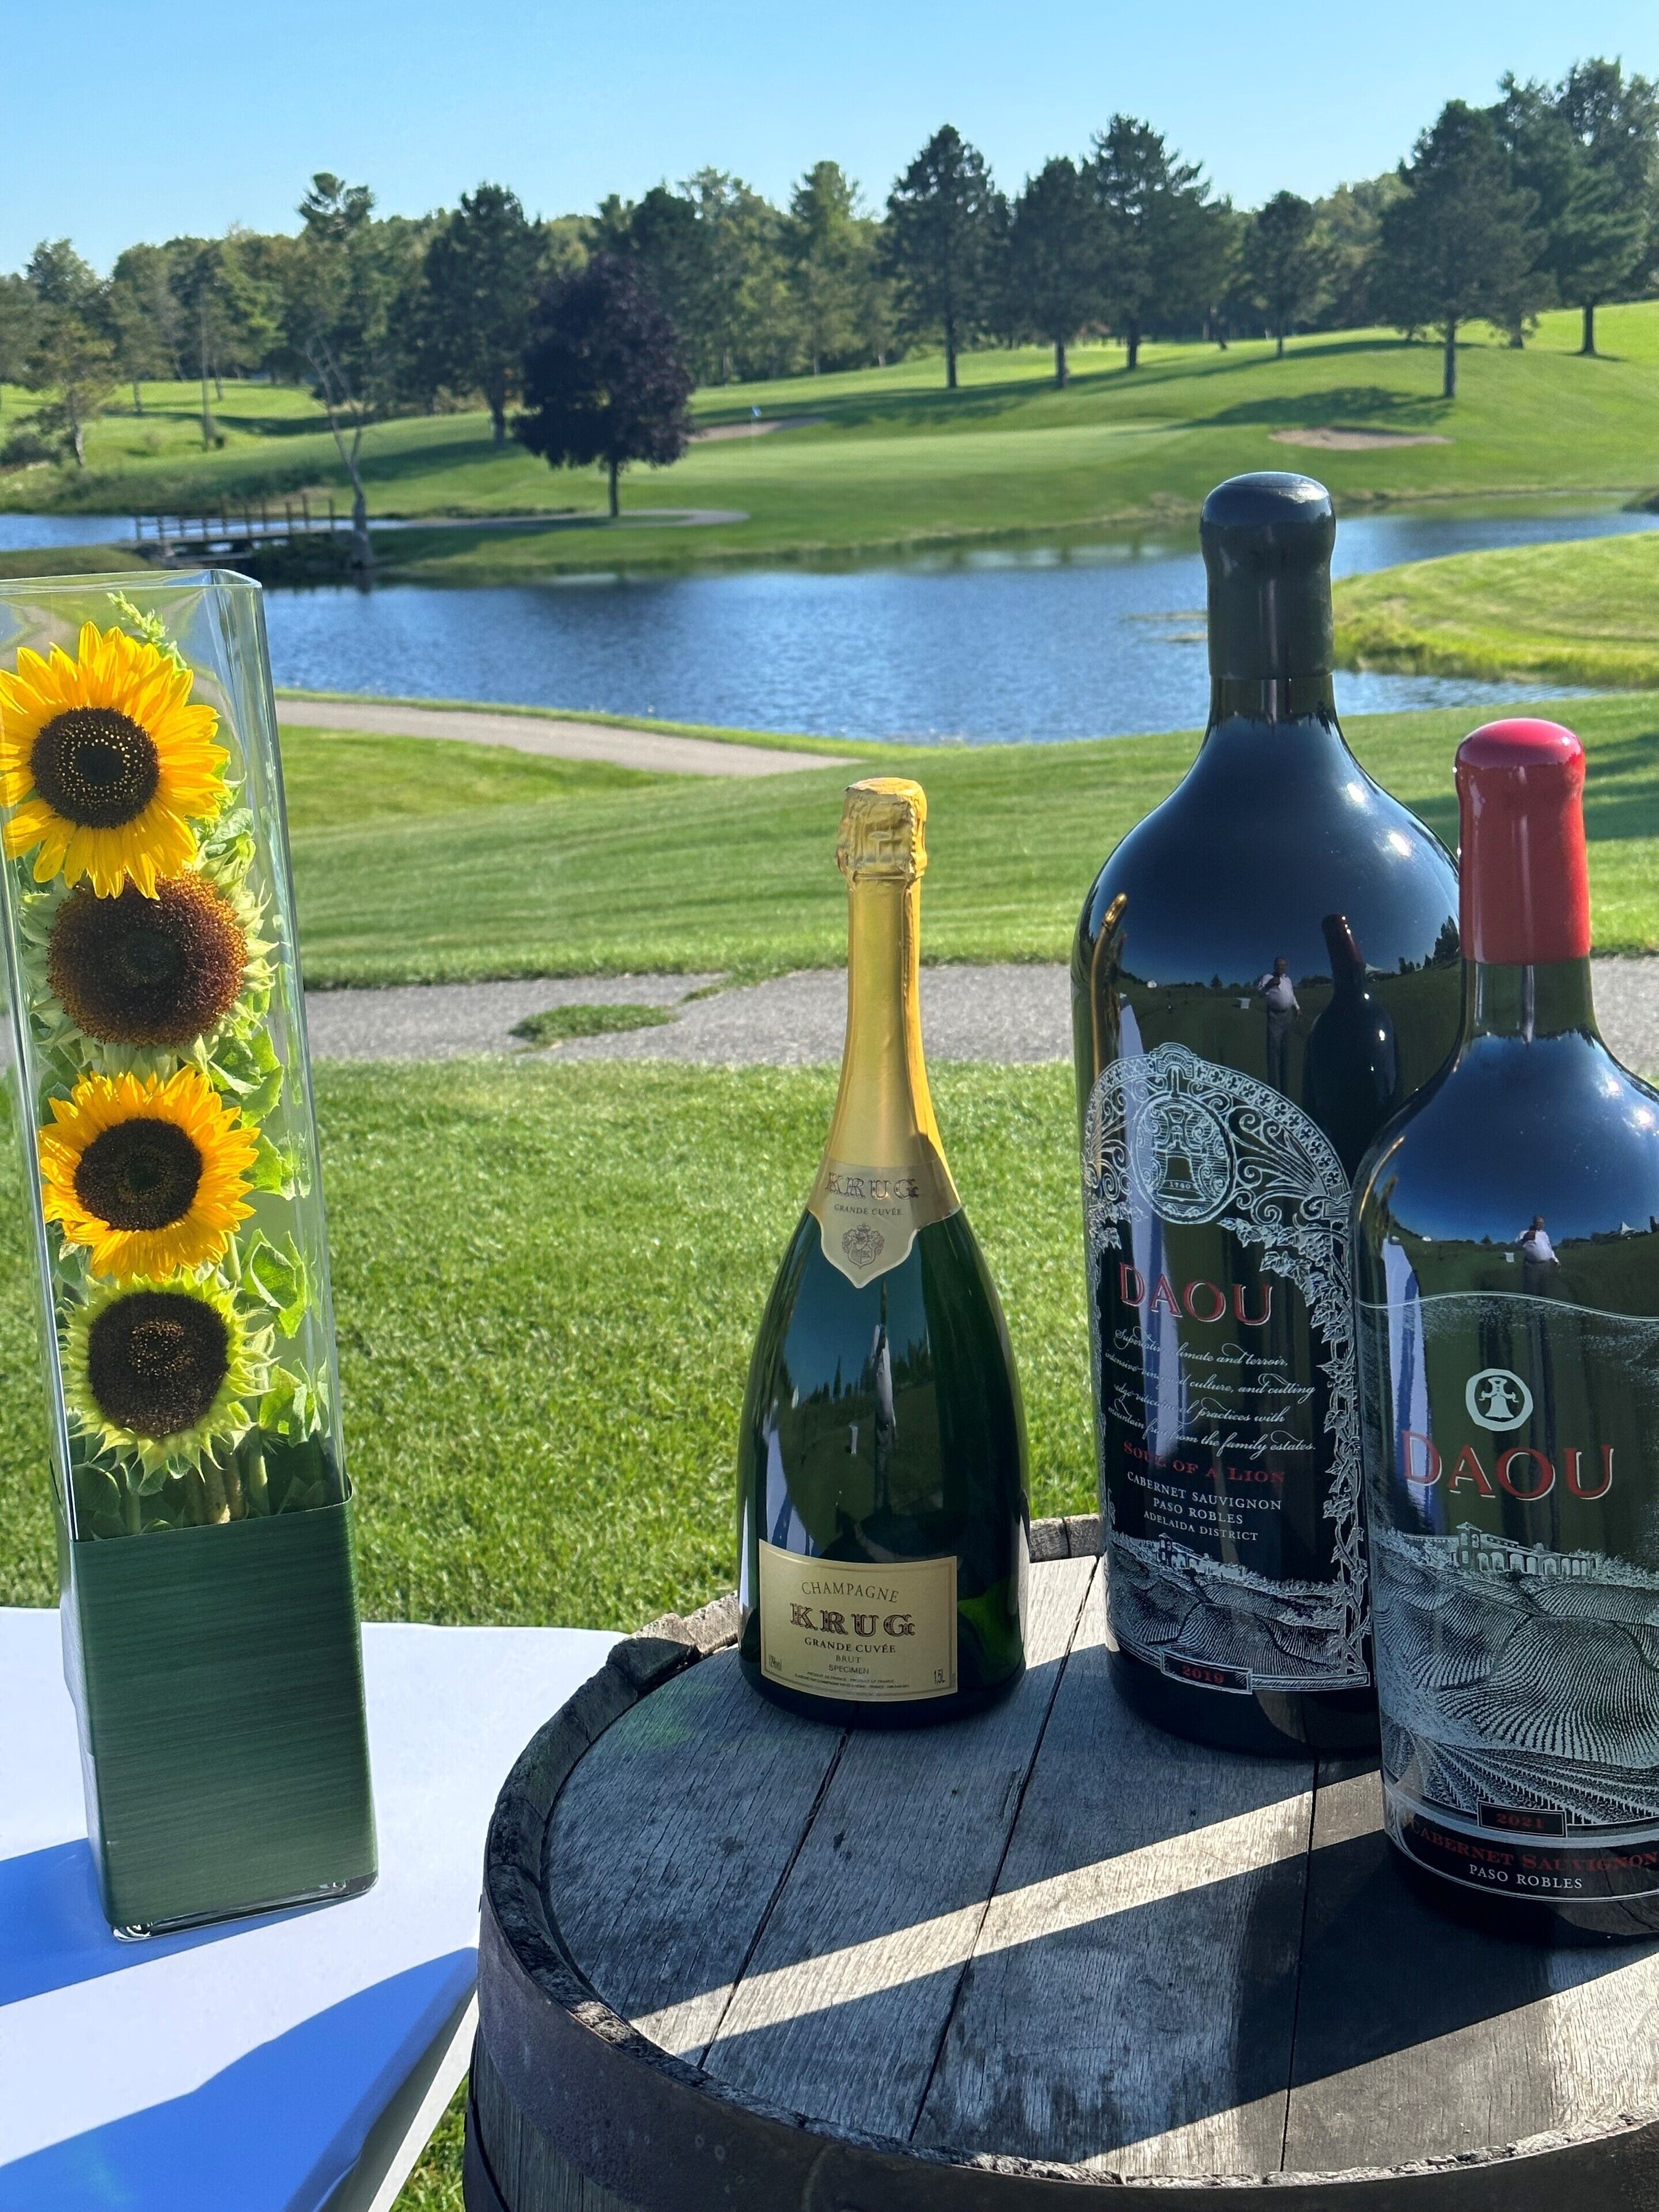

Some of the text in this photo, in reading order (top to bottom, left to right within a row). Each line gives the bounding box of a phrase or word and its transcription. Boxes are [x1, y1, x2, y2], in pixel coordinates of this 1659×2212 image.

[825, 1172, 919, 1200] KRUG
[834, 1204, 902, 1216] GRANDE CUVÉE
[1119, 1262, 1273, 1325] DAOU
[1216, 1351, 1248, 1365] and
[1243, 1346, 1288, 1366] terroir,
[1190, 1374, 1234, 1393] culture,
[1238, 1381, 1269, 1394] and
[1262, 1374, 1316, 1404] cutting
[1191, 1399, 1251, 1424] practices
[1254, 1406, 1290, 1422] with
[1200, 1430, 1220, 1446] the
[1216, 1432, 1268, 1460] family
[1270, 1430, 1316, 1450] estates.
[1172, 1460, 1199, 1474] OF
[1205, 1467, 1218, 1479] A
[1228, 1467, 1286, 1483] LION
[1402, 1430, 1614, 1501] DAOU
[1127, 1471, 1282, 1510] CABERNET SAUVIGNON
[1153, 1497, 1243, 1525] PASO ROBLES
[1143, 1510, 1259, 1541] ADELAIDA DISTRICT
[801, 1582, 899, 1603] CHAMPAGNE
[790, 1603, 915, 1637] KRUG
[805, 1637, 896, 1653] GRANDE CUVÉE
[828, 1664, 870, 1675] SPECIMEN
[836, 1654, 862, 1664] BRUT
[1182, 1665, 1225, 1684] 2019
[1497, 1813, 1544, 1828] 2021
[1411, 1819, 1659, 1871] CABERNET SAUVIGNON
[1469, 1863, 1582, 1889] PASO ROBLES
